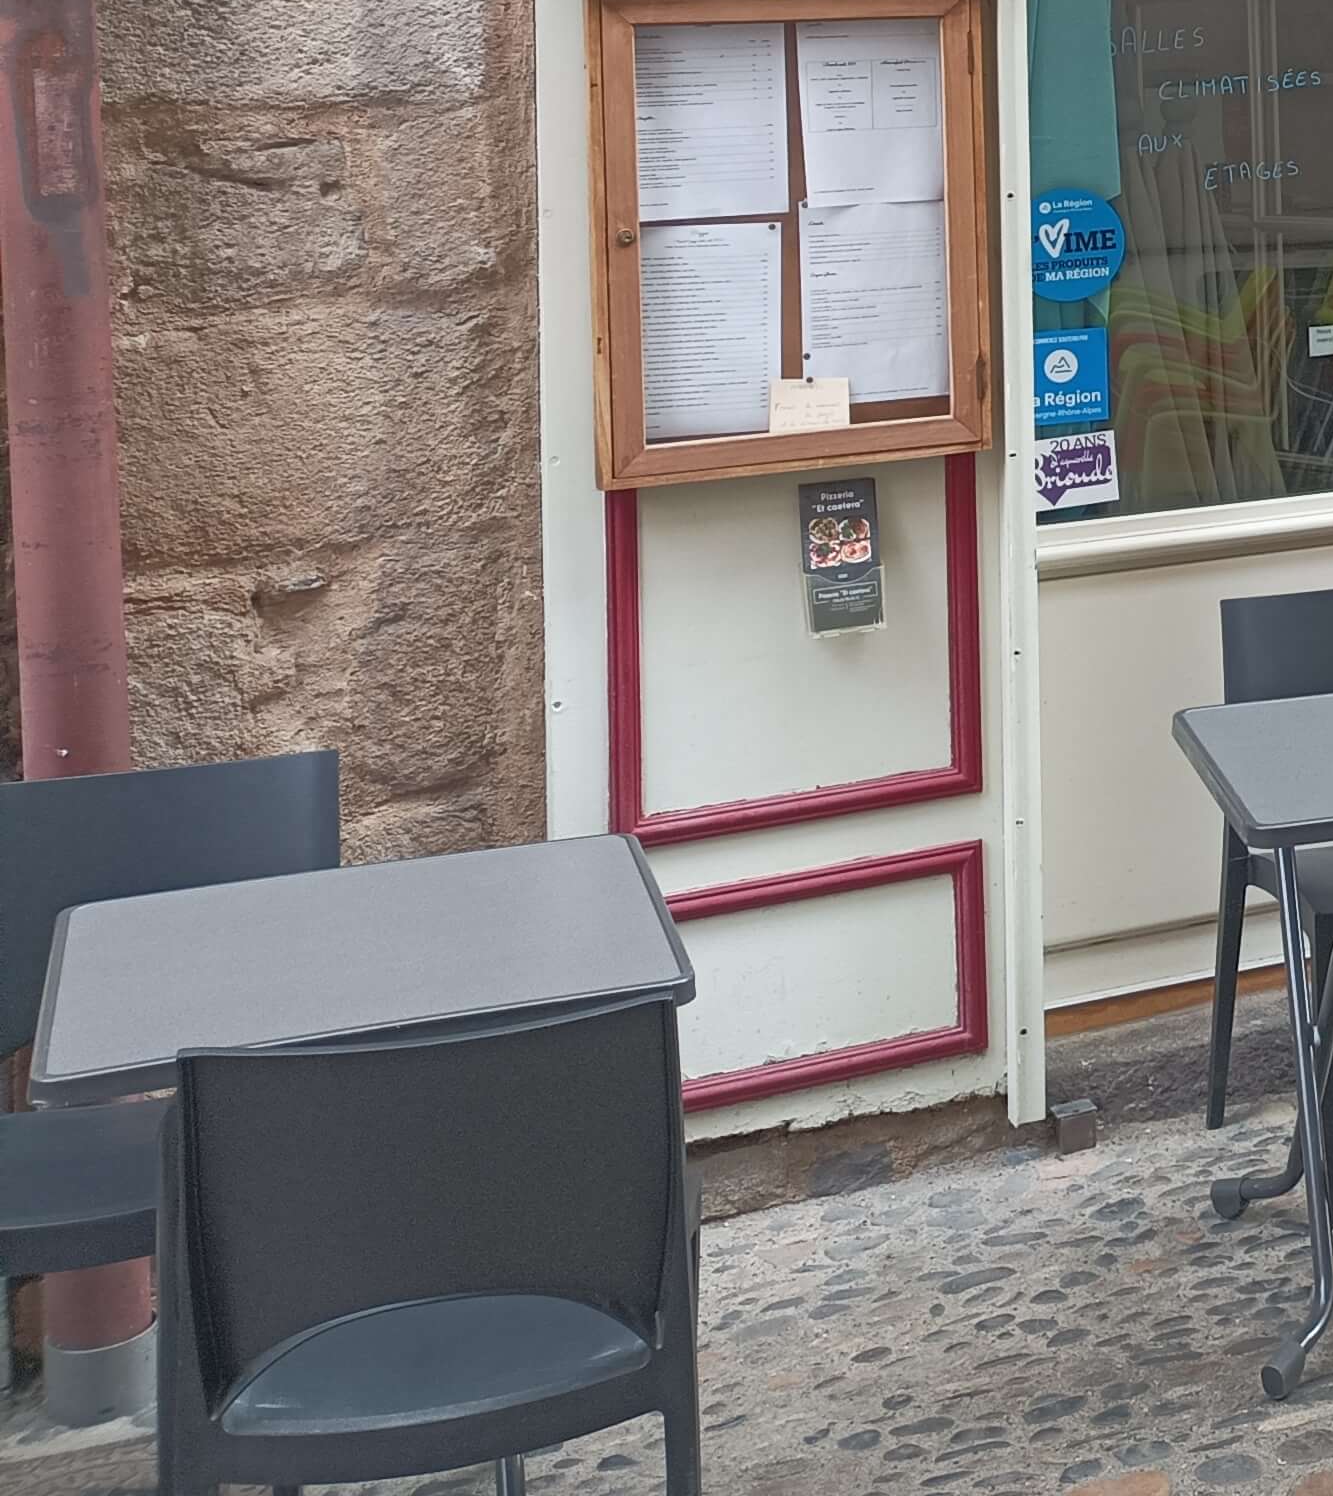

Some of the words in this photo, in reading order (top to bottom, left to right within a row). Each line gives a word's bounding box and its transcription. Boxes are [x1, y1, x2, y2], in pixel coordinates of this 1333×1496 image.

[1138, 133, 1184, 156] AUX
[1045, 271, 1064, 282] MA
[1066, 266, 1110, 280] RÉGION
[1045, 390, 1102, 407] Région
[1050, 439, 1070, 452] 20
[1073, 433, 1107, 449] ANS
